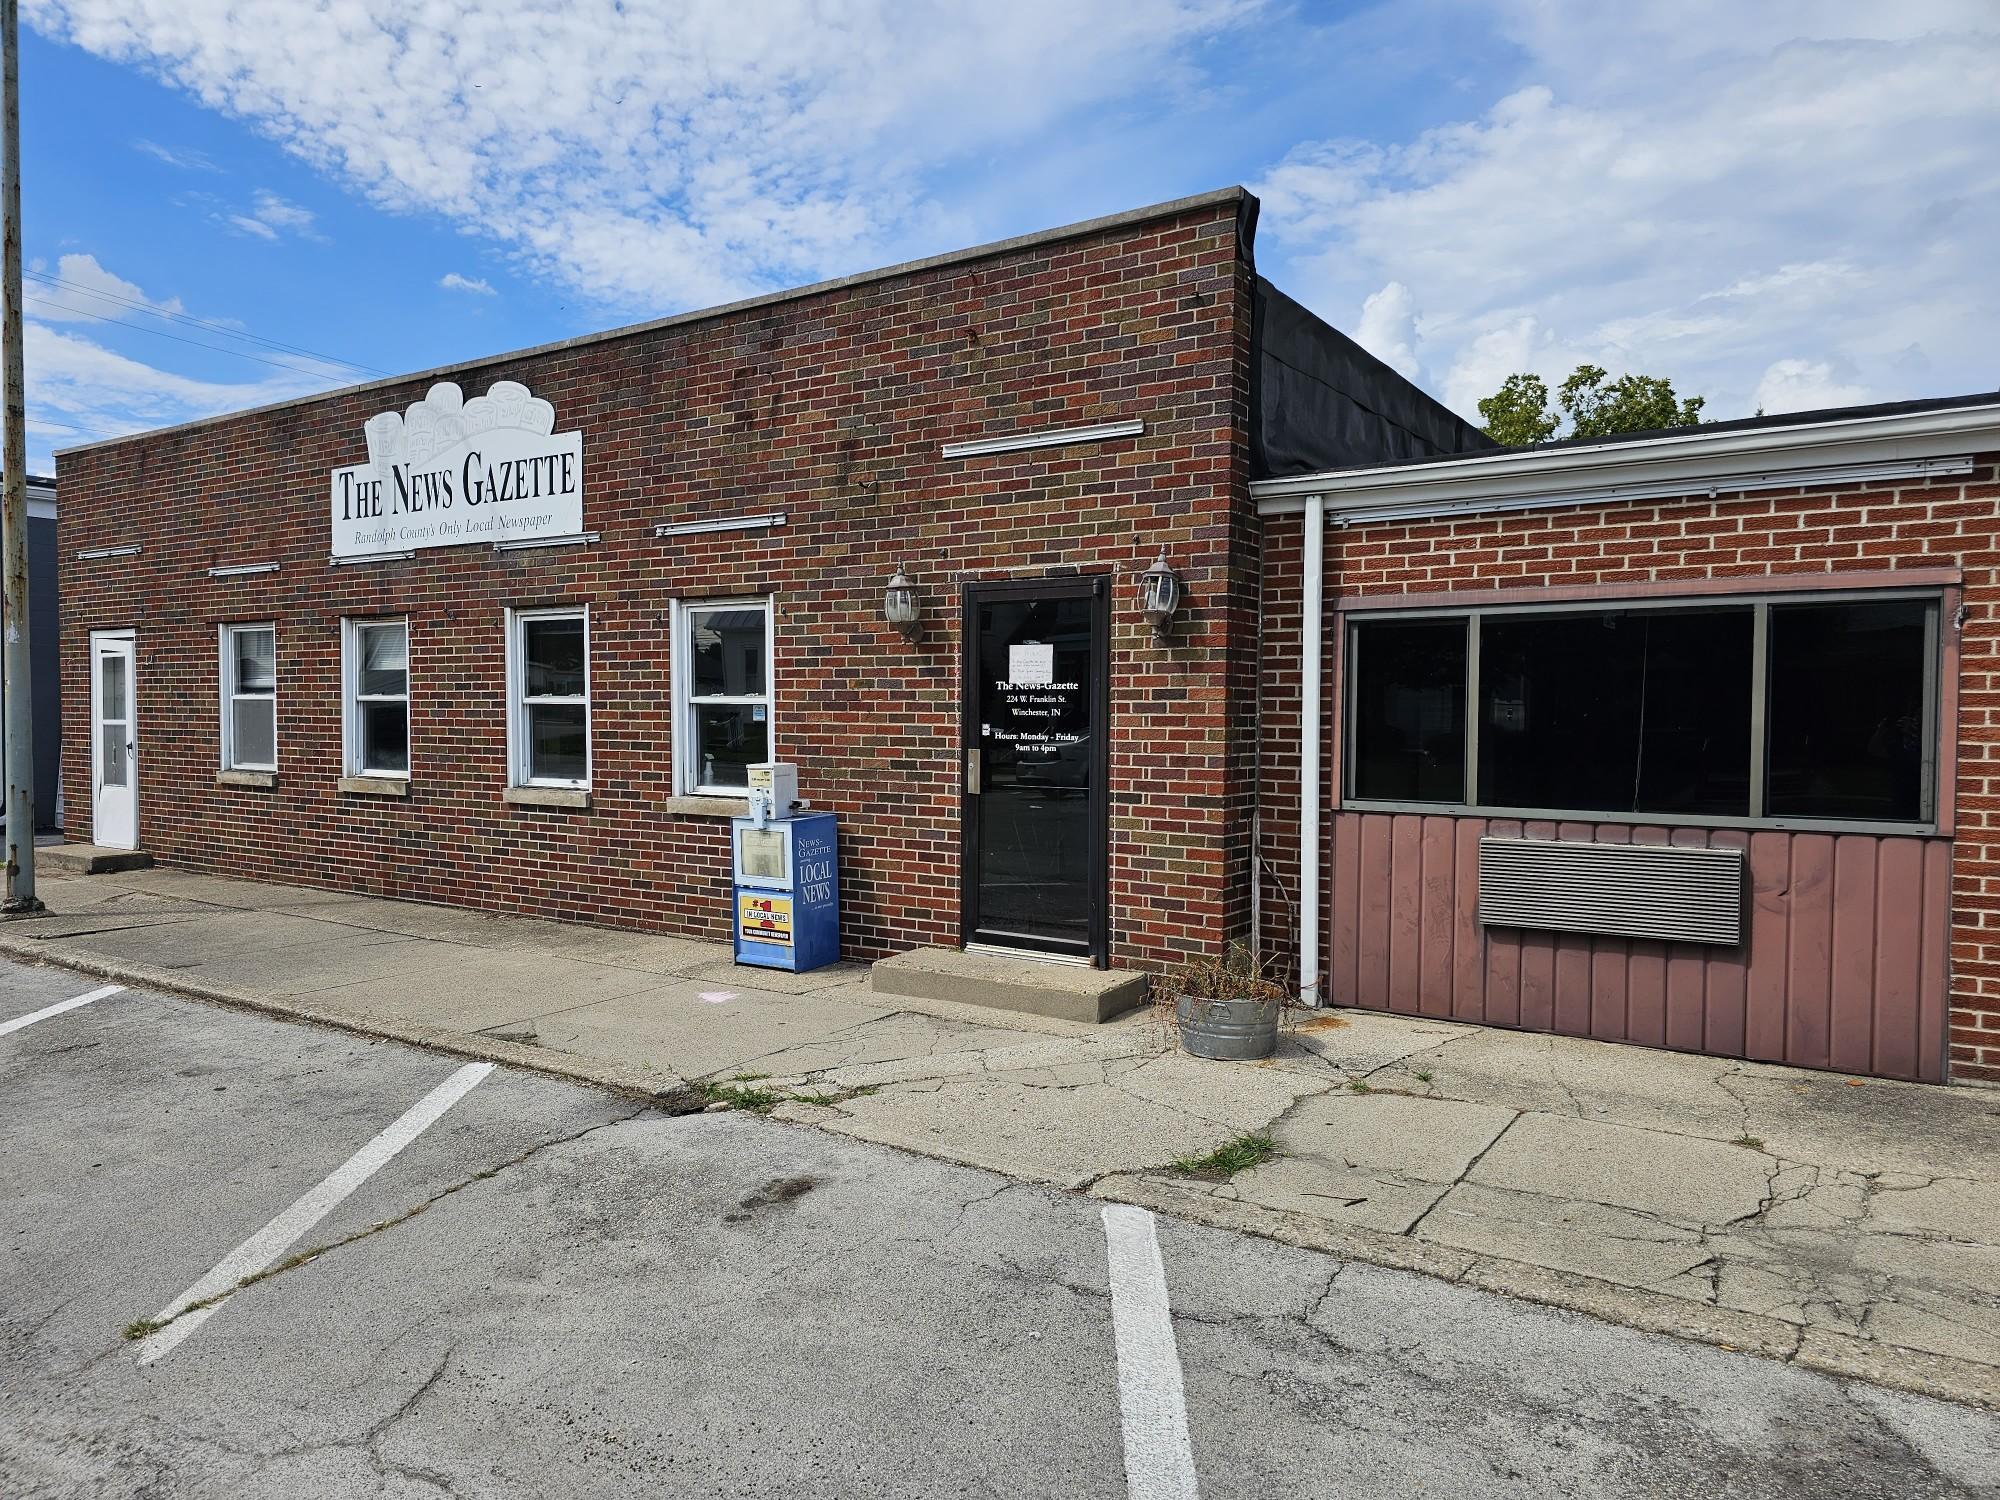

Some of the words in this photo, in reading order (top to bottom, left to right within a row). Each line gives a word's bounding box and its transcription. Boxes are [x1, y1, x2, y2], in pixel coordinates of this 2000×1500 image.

[339, 471, 383, 521] THE
[392, 462, 453, 515] NEWS
[462, 451, 576, 506] GAZETTE
[354, 530, 396, 546] Randolph
[399, 523, 435, 540] County's
[439, 519, 462, 536] Only
[466, 515, 493, 533] Local
[497, 512, 553, 531] Newspaper
[995, 681, 1014, 690] The
[1015, 682, 1079, 690] News-Gazette
[1006, 695, 1018, 703] 224
[1020, 695, 1028, 703] W.
[1029, 695, 1057, 703] Franklin
[1058, 695, 1067, 703] St.
[1011, 708, 1050, 717] Winchester,
[1051, 708, 1061, 716] IN
[994, 732, 1019, 740] Hours:
[1020, 732, 1049, 742] Monday
[1055, 733, 1079, 743] Friday
[1015, 743, 1031, 752] 9am
[1040, 744, 1057, 754] 4pm
[798, 846, 832, 858] GAZETTE
[800, 860, 833, 884] LOCAL
[802, 881, 831, 905] NEWS
[746, 910, 753, 918] IN
[753, 911, 770, 920] LOCAL
[770, 913, 786, 922] NEWS
